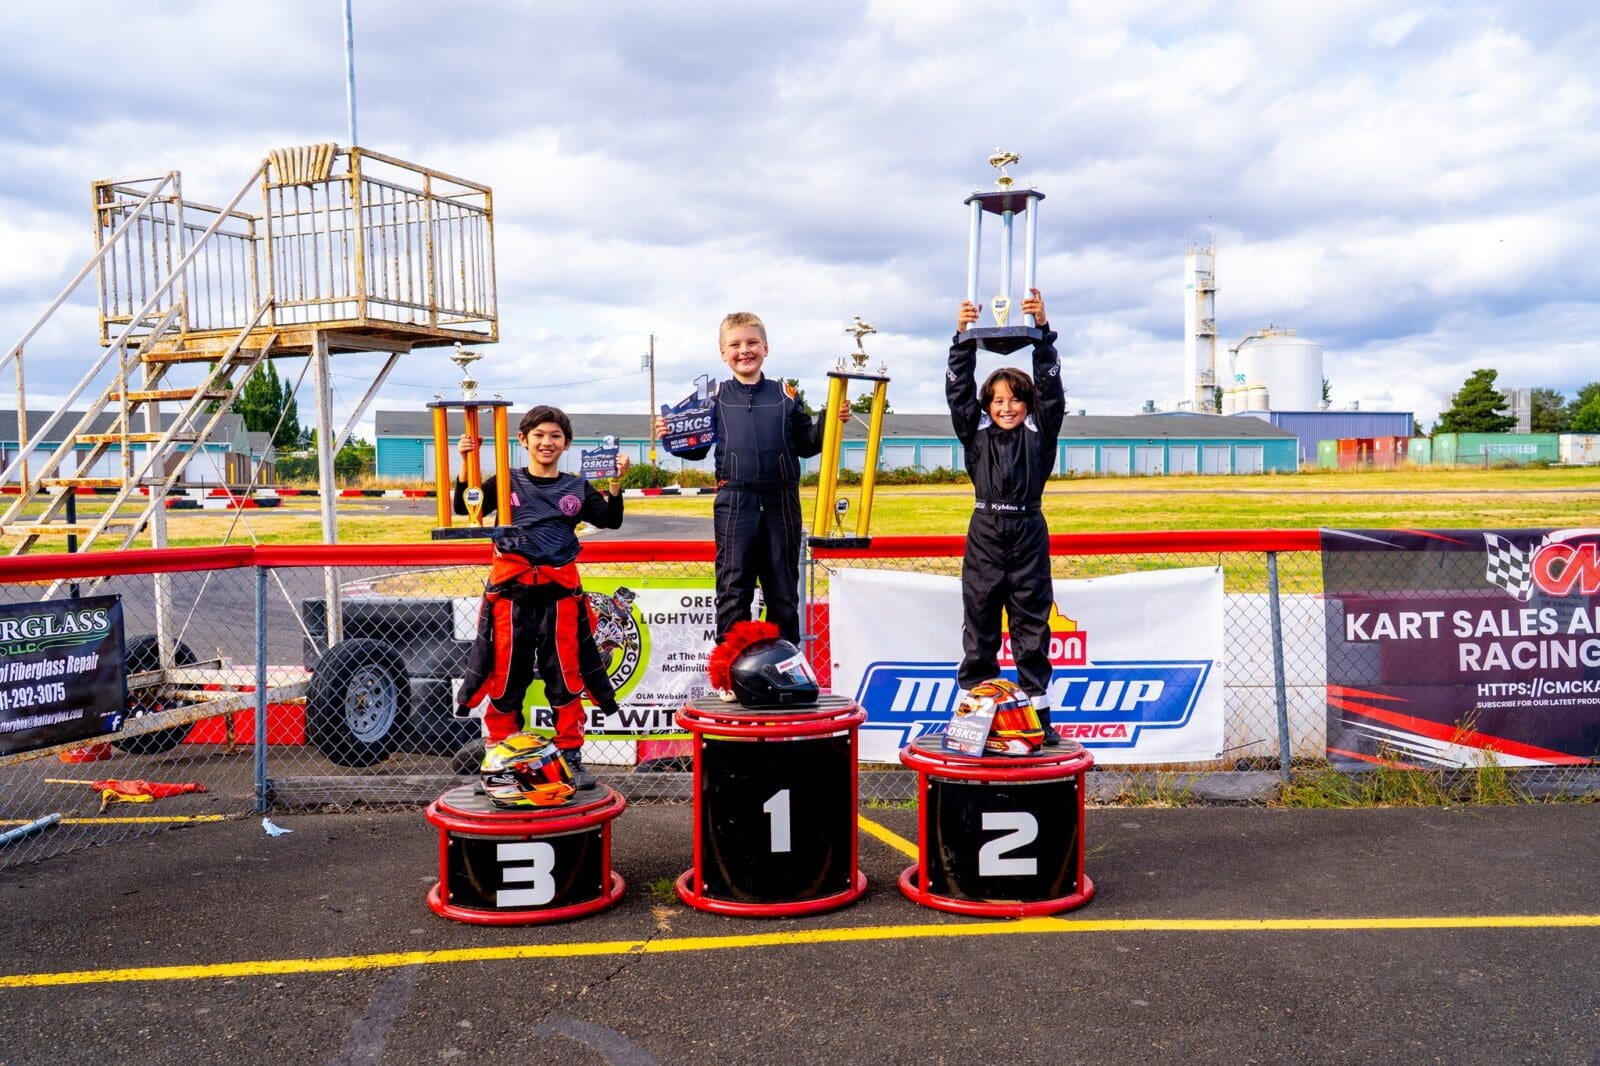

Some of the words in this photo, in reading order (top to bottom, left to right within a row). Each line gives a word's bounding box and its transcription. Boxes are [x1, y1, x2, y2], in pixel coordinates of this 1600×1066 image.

[693, 375, 708, 400] 1
[602, 435, 615, 449] 3
[582, 460, 615, 468] OSKCS
[1346, 611, 1444, 641] KART
[1453, 608, 1558, 638] SALES
[9, 643, 36, 656] LLC
[610, 620, 638, 687] ORGON
[667, 653, 676, 661] at
[679, 653, 696, 661] The
[1459, 638, 1600, 671] RACING
[11, 657, 65, 681] Fiberglass
[66, 652, 99, 674] Repair
[635, 693, 654, 701] OLM
[656, 693, 688, 701] Website
[1050, 677, 1164, 711] CUP
[1477, 701, 1516, 709] SUBSCRIBE
[1550, 698, 1576, 706] LATEST
[762, 788, 792, 854] 1
[977, 812, 1039, 878] 2
[495, 842, 556, 908] 3
